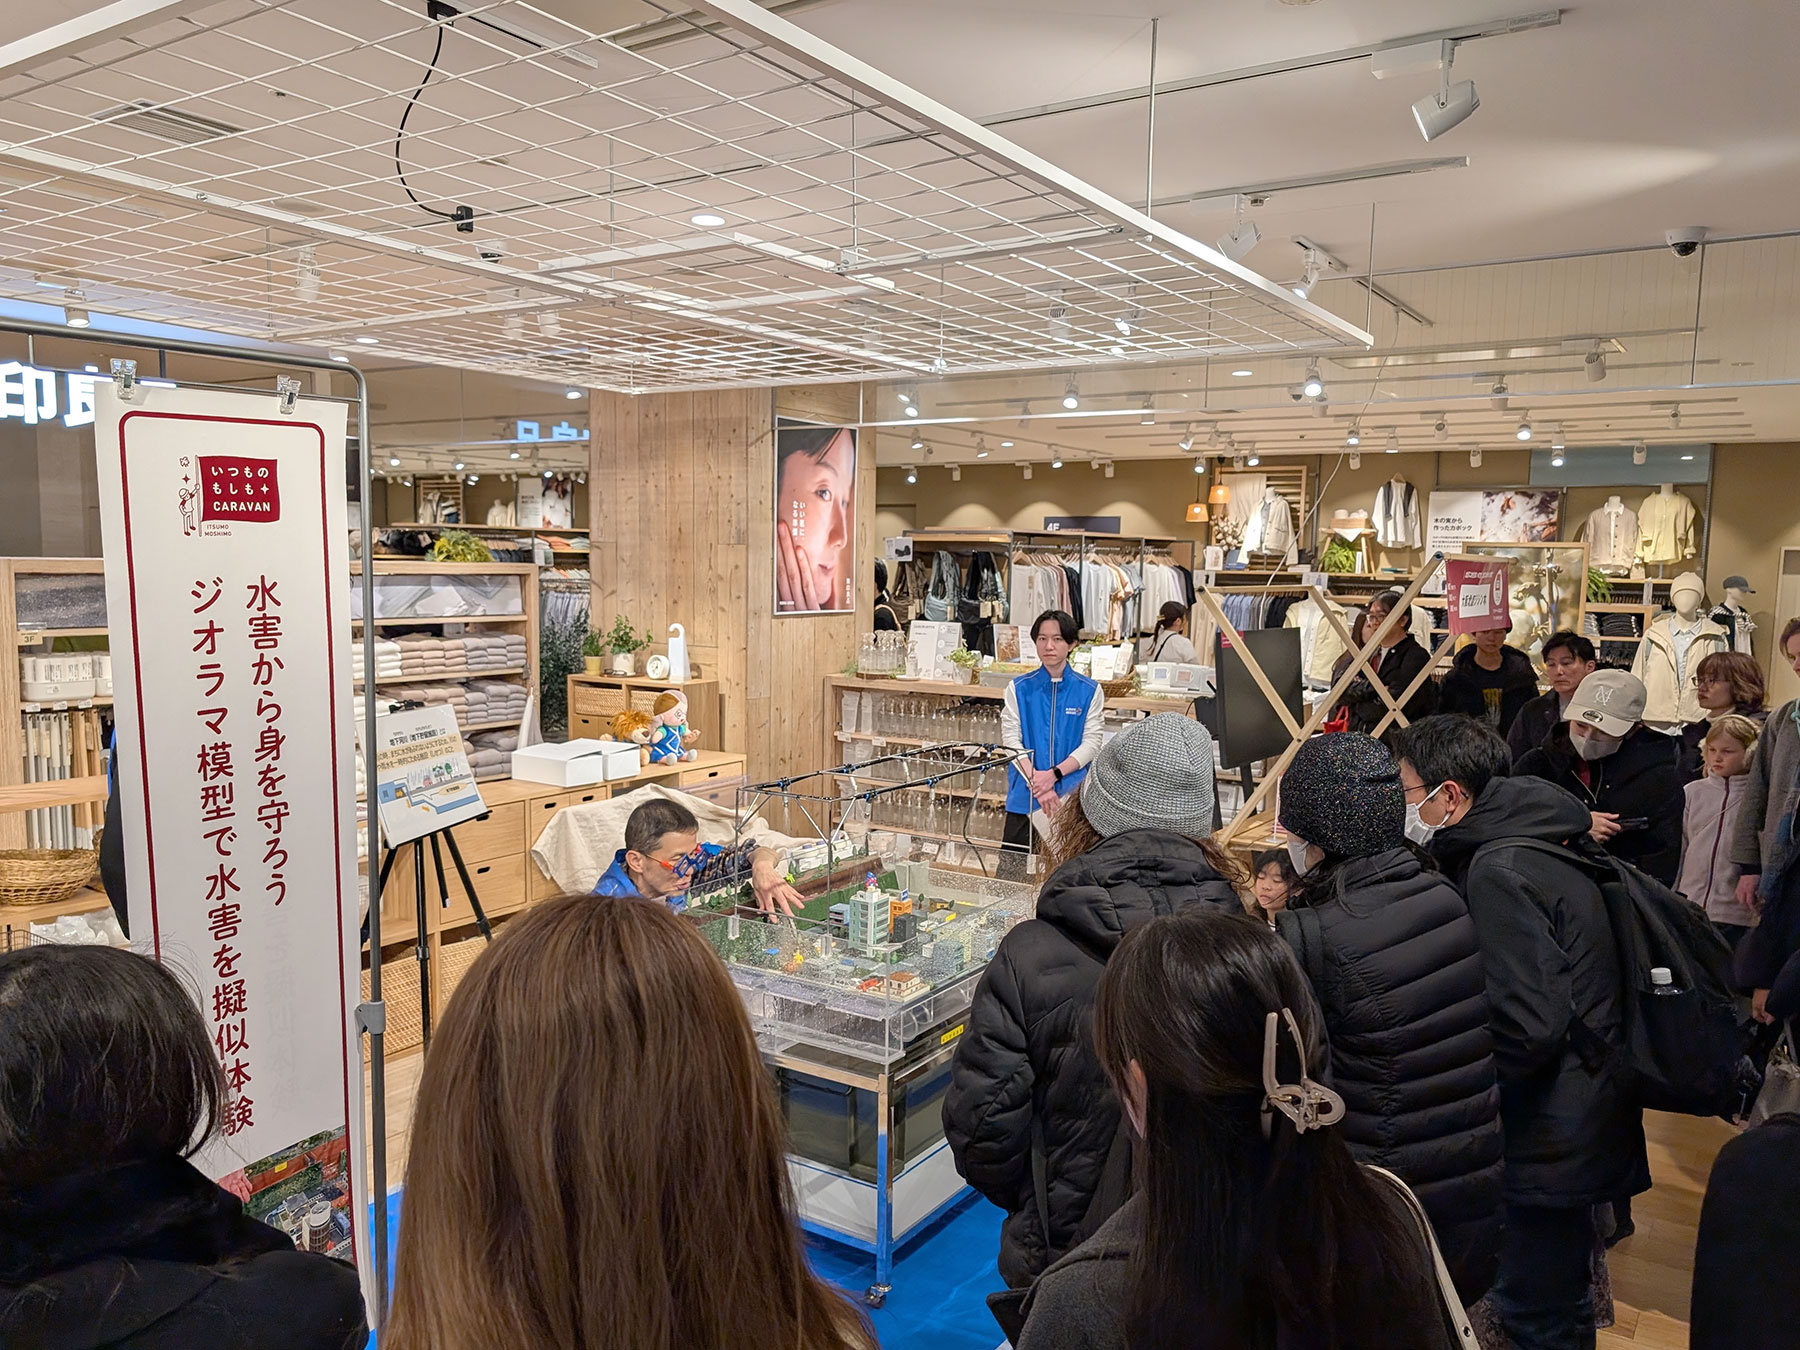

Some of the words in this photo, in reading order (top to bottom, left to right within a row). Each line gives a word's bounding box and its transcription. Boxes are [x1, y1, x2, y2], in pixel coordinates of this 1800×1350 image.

[211, 466, 269, 479] いつもの
[212, 482, 254, 495] もしも
[213, 501, 271, 512] CARAVAN
[246, 574, 290, 906] 水害から身を守ろう
[191, 576, 255, 1137] ジオラマ模型で水害を擬似体験
